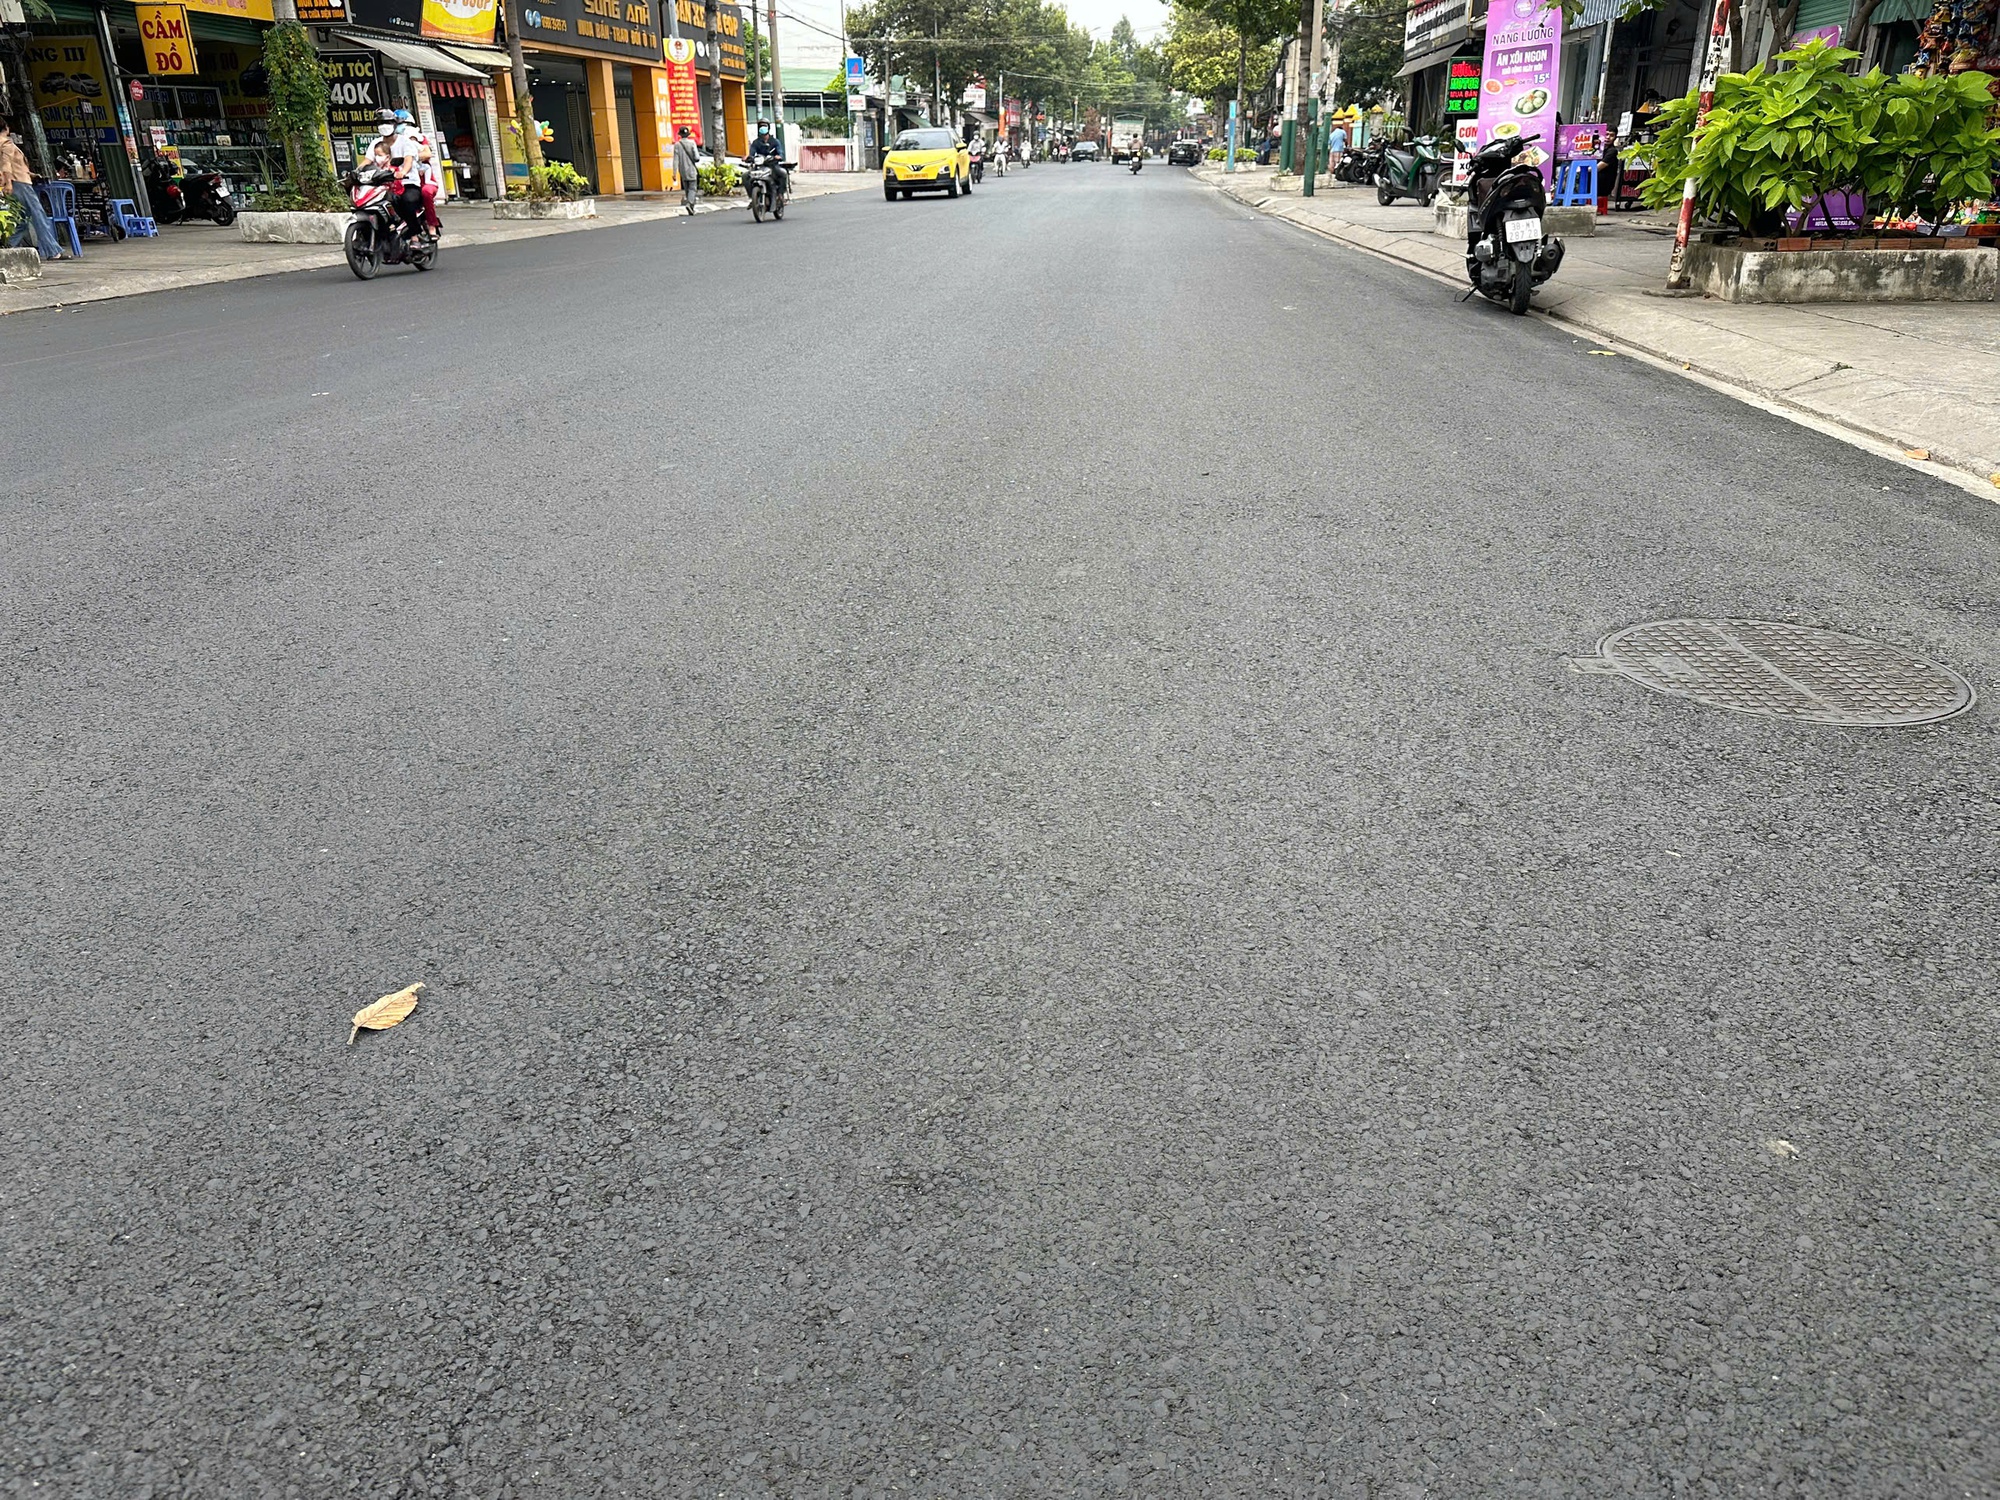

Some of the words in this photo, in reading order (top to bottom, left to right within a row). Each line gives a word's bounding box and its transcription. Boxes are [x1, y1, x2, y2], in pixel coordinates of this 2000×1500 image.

[142, 11, 184, 39] CẦM
[63, 46, 87, 62] III
[155, 42, 183, 71] ĐỒ
[1509, 51, 1523, 65] XÔI
[1523, 49, 1548, 63] NGON
[323, 57, 344, 79] CẮT
[347, 58, 374, 78] TÓC
[1450, 77, 1480, 90] MOTOR
[330, 82, 374, 105] 40K
[1447, 99, 1462, 111] XE
[1463, 97, 1477, 111] CŨ
[349, 110, 362, 121] TAI
